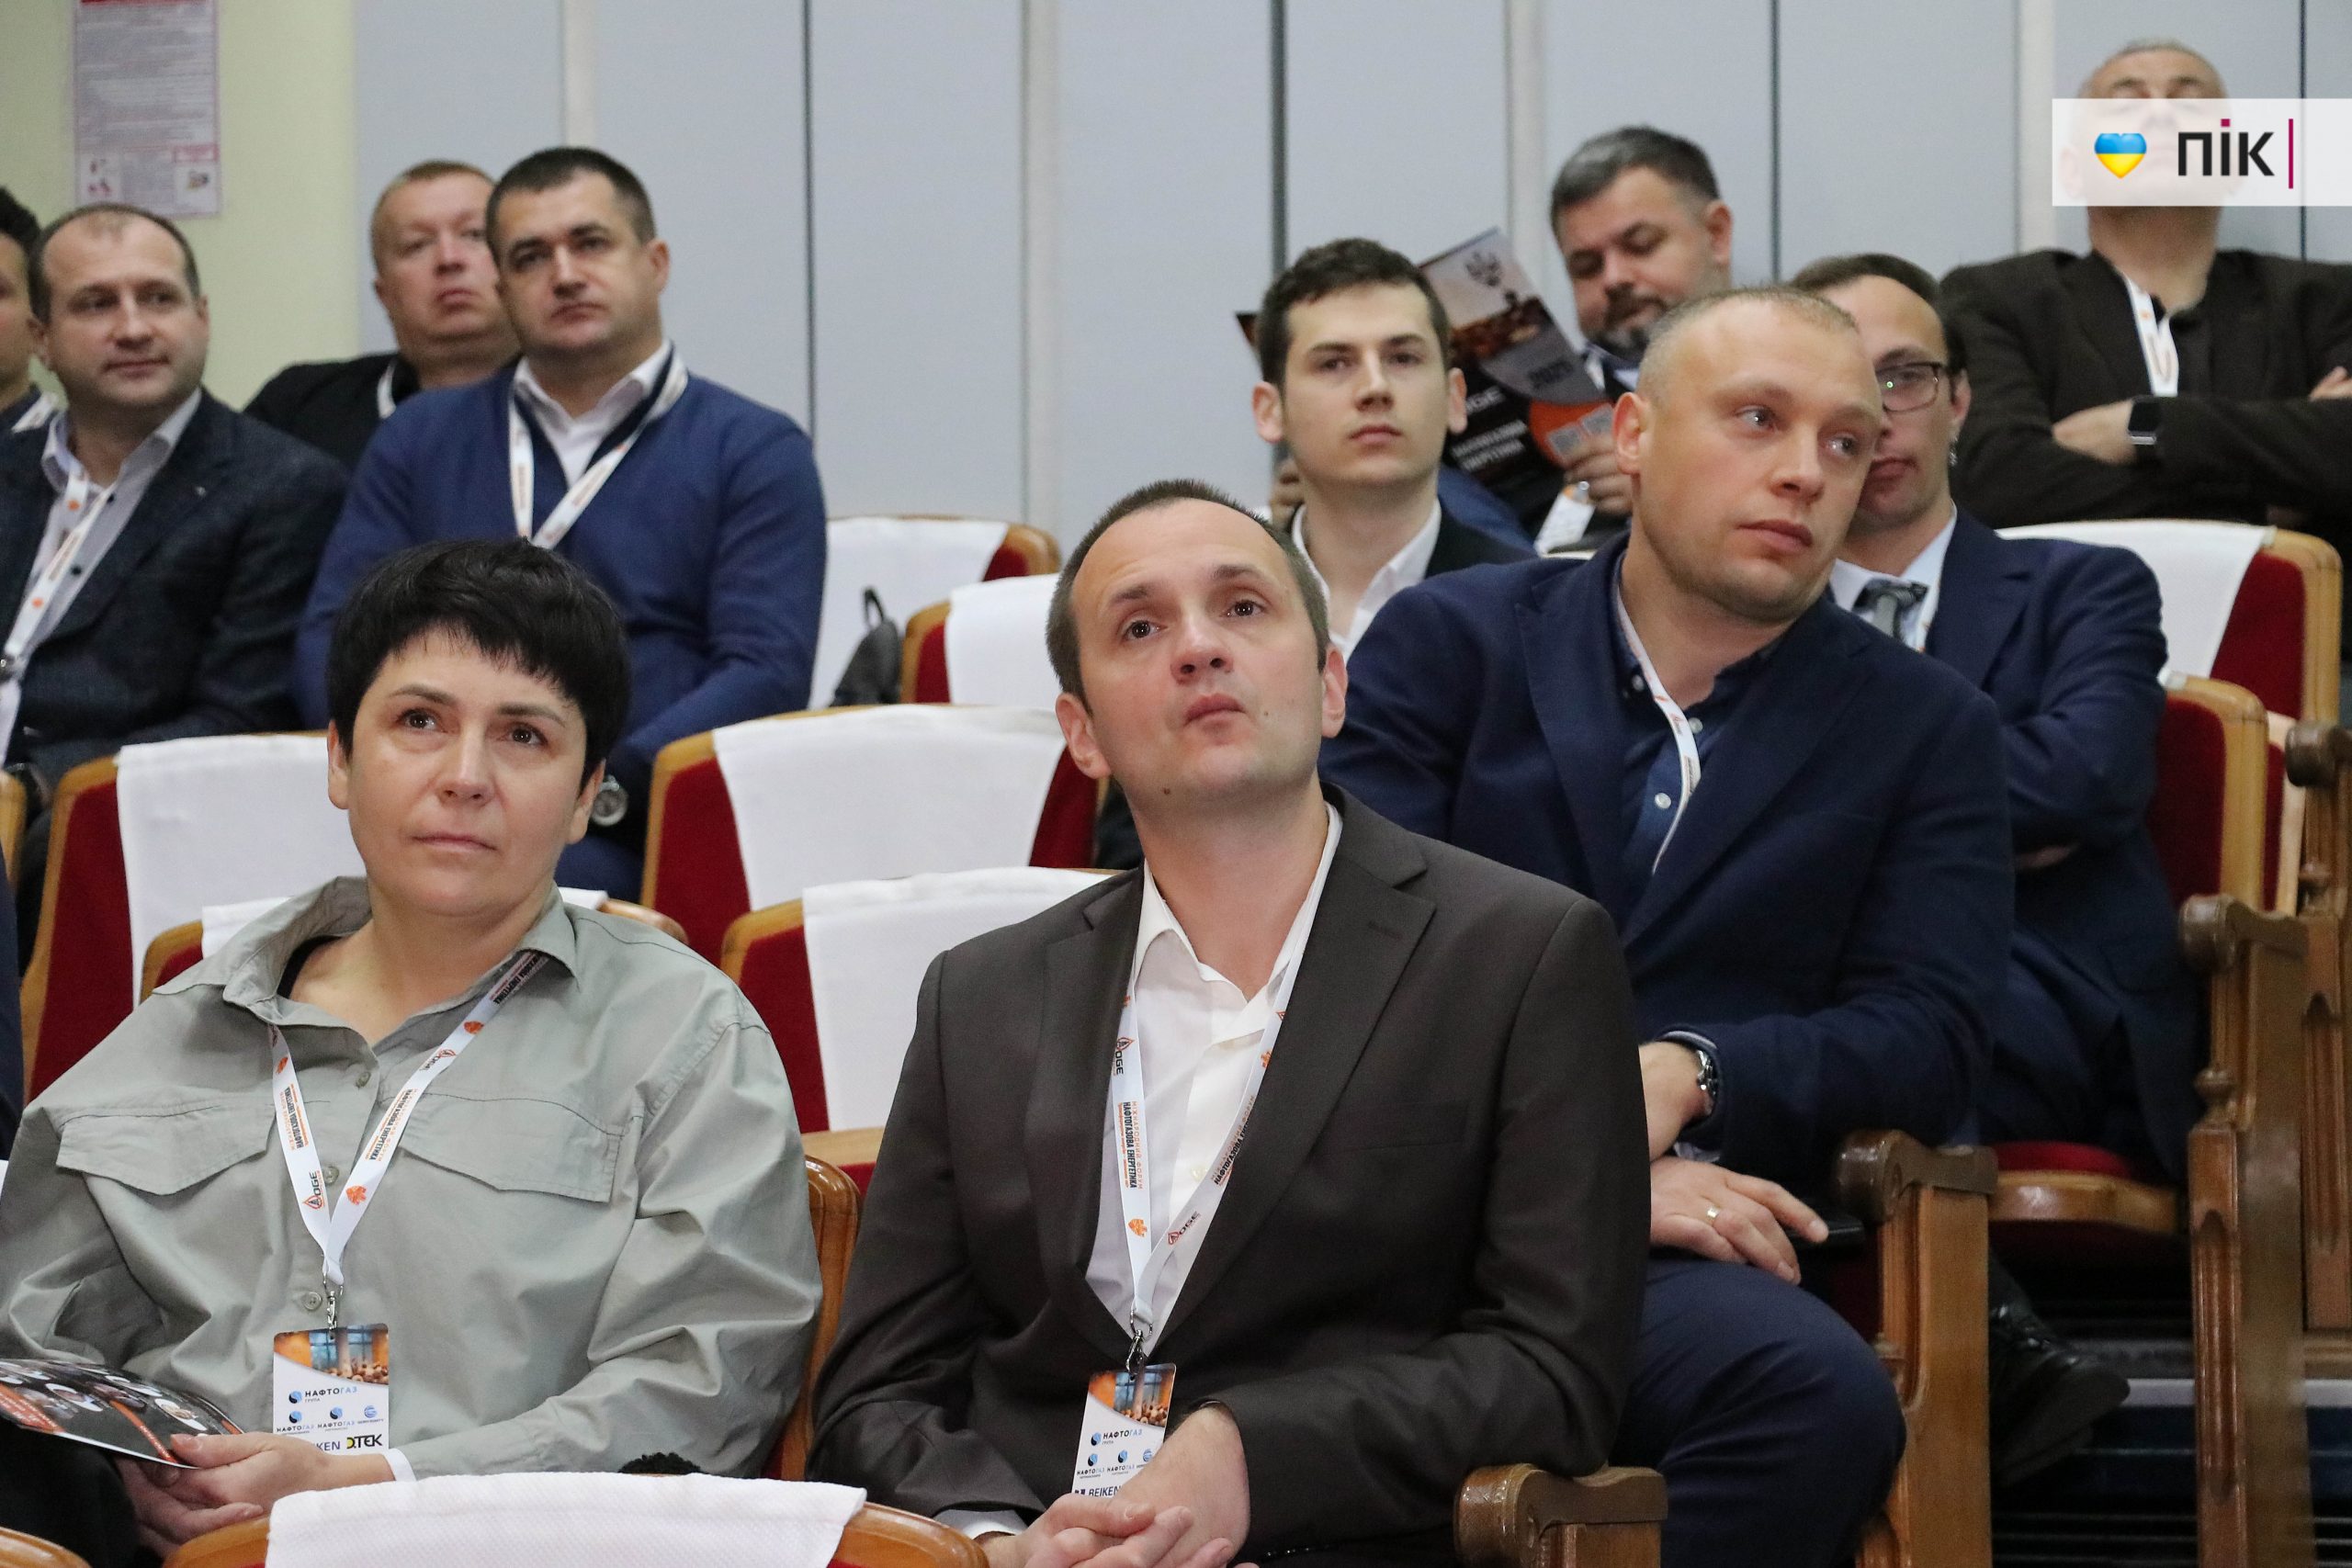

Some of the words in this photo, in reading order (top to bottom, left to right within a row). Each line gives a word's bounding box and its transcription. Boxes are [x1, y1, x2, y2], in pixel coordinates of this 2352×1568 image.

[1115, 1051, 1124, 1075] OGE
[1123, 1101, 1135, 1148] НАФТОГАЗОВА
[1132, 1101, 1142, 1158] МІЖНАРОДНИЙ
[1126, 1149, 1137, 1188] ЕНЕРГЕТИКА
[1214, 1139, 1243, 1185] НАФТОГАЗОВА
[310, 1171, 321, 1197] OGE
[305, 1386, 357, 1397] НАФТОГАЗ
[1102, 1428, 1143, 1439] НАФТОГАЗ
[1107, 1464, 1136, 1472] НАФТОГАЗ
